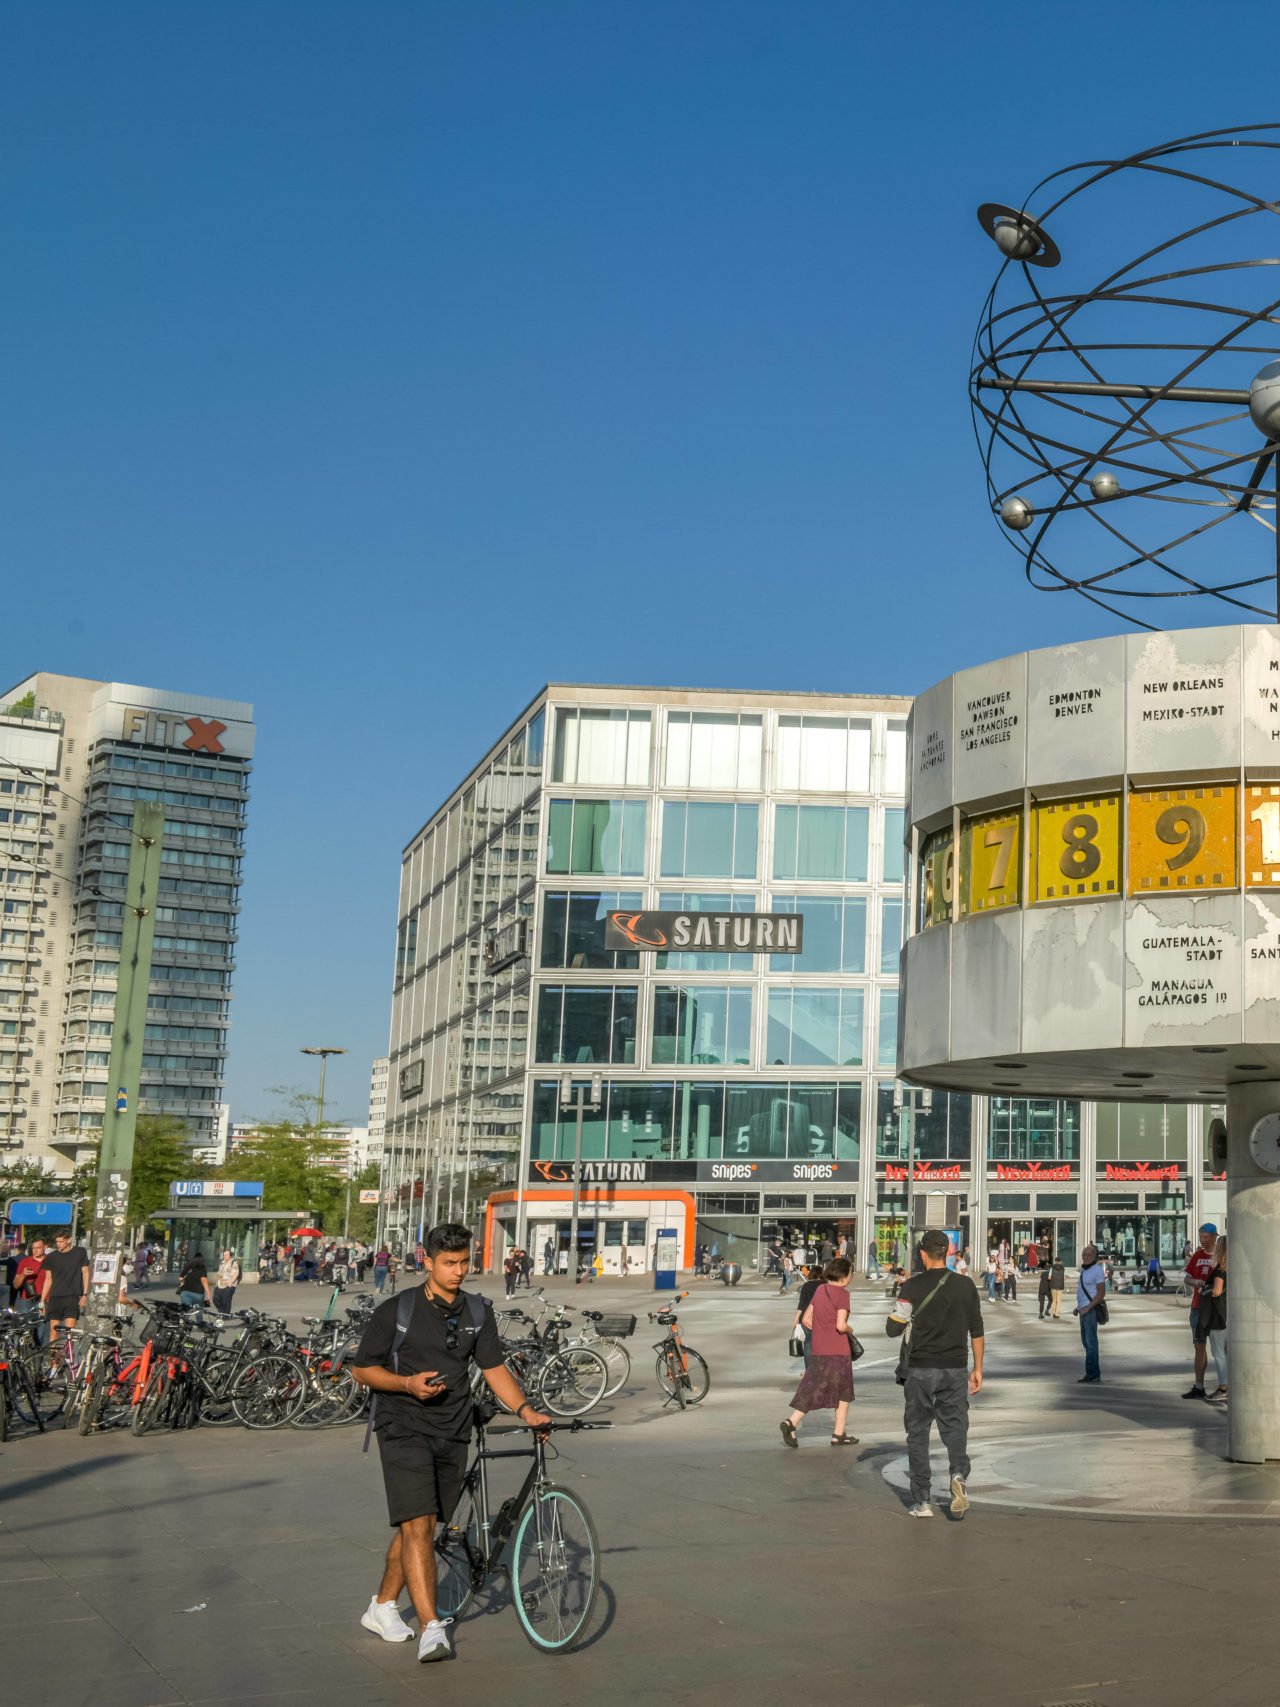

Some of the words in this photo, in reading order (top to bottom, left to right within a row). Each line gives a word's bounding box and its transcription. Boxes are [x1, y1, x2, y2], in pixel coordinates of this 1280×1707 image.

[1143, 682, 1168, 695] NEW
[1172, 678, 1224, 693] ORLEANS
[967, 690, 1011, 712] VANCOUVER
[1049, 687, 1101, 706] EDMONTON
[973, 705, 1005, 723] DAWSON
[1055, 702, 1094, 718] DENVER
[1142, 705, 1225, 721] MEXIKO-STADT
[960, 727, 974, 740] SAN
[976, 715, 1018, 736] FRANCISCO
[966, 739, 979, 751] LOS
[980, 730, 1011, 749] ANGELES
[1059, 813, 1102, 879] 8
[1155, 805, 1206, 870] 9
[984, 825, 1018, 891] 7
[673, 916, 798, 948] SATURN
[1142, 936, 1222, 949] GUATEMALA-
[1186, 949, 1222, 961] STADT
[1151, 978, 1214, 992] MANAGUA
[1138, 991, 1208, 1006] GALÁPAGOS
[712, 1163, 752, 1181] snipes
[793, 1163, 833, 1181] snipes
[176, 1182, 188, 1195] U
[36, 1203, 48, 1215] U
